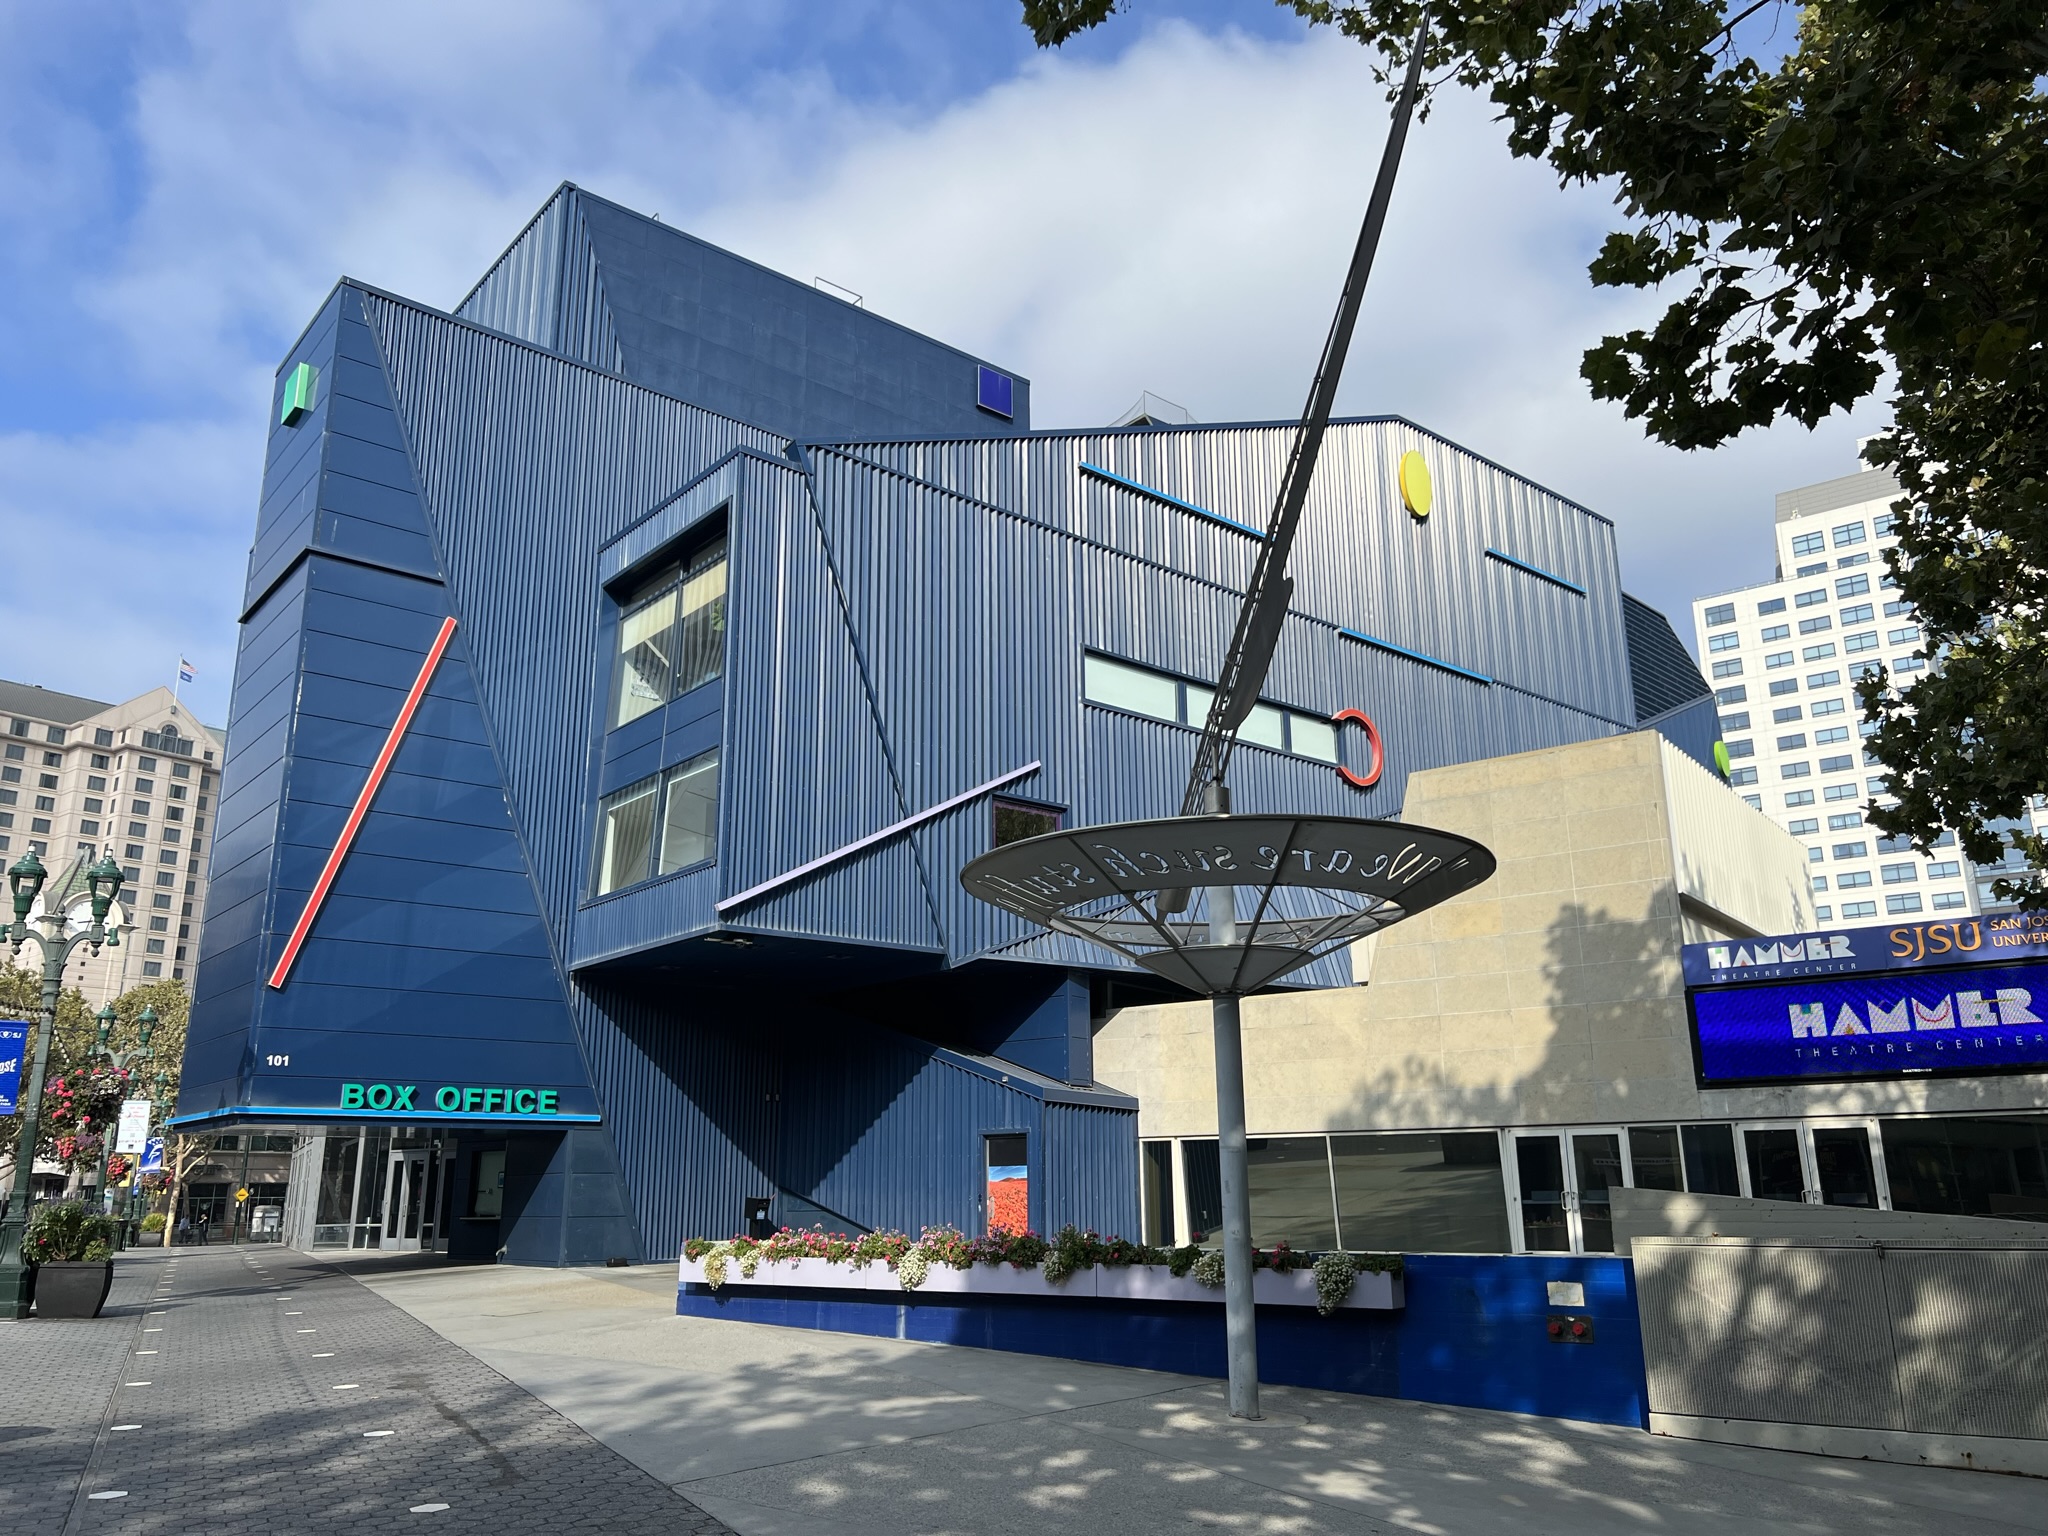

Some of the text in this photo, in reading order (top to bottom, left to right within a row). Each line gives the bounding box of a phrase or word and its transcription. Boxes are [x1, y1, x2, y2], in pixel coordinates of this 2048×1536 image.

[1990, 918, 2021, 931] SAN
[1707, 935, 1857, 970] HAMMER
[1889, 921, 1982, 962] SJSU
[1711, 963, 1857, 982] THEATRE CENTER
[1788, 987, 2044, 1038] HAMMER
[265, 1054, 290, 1067] 101
[1794, 1033, 2045, 1059] THEATRE CENTER
[341, 1083, 558, 1115] BOX OFFICE
